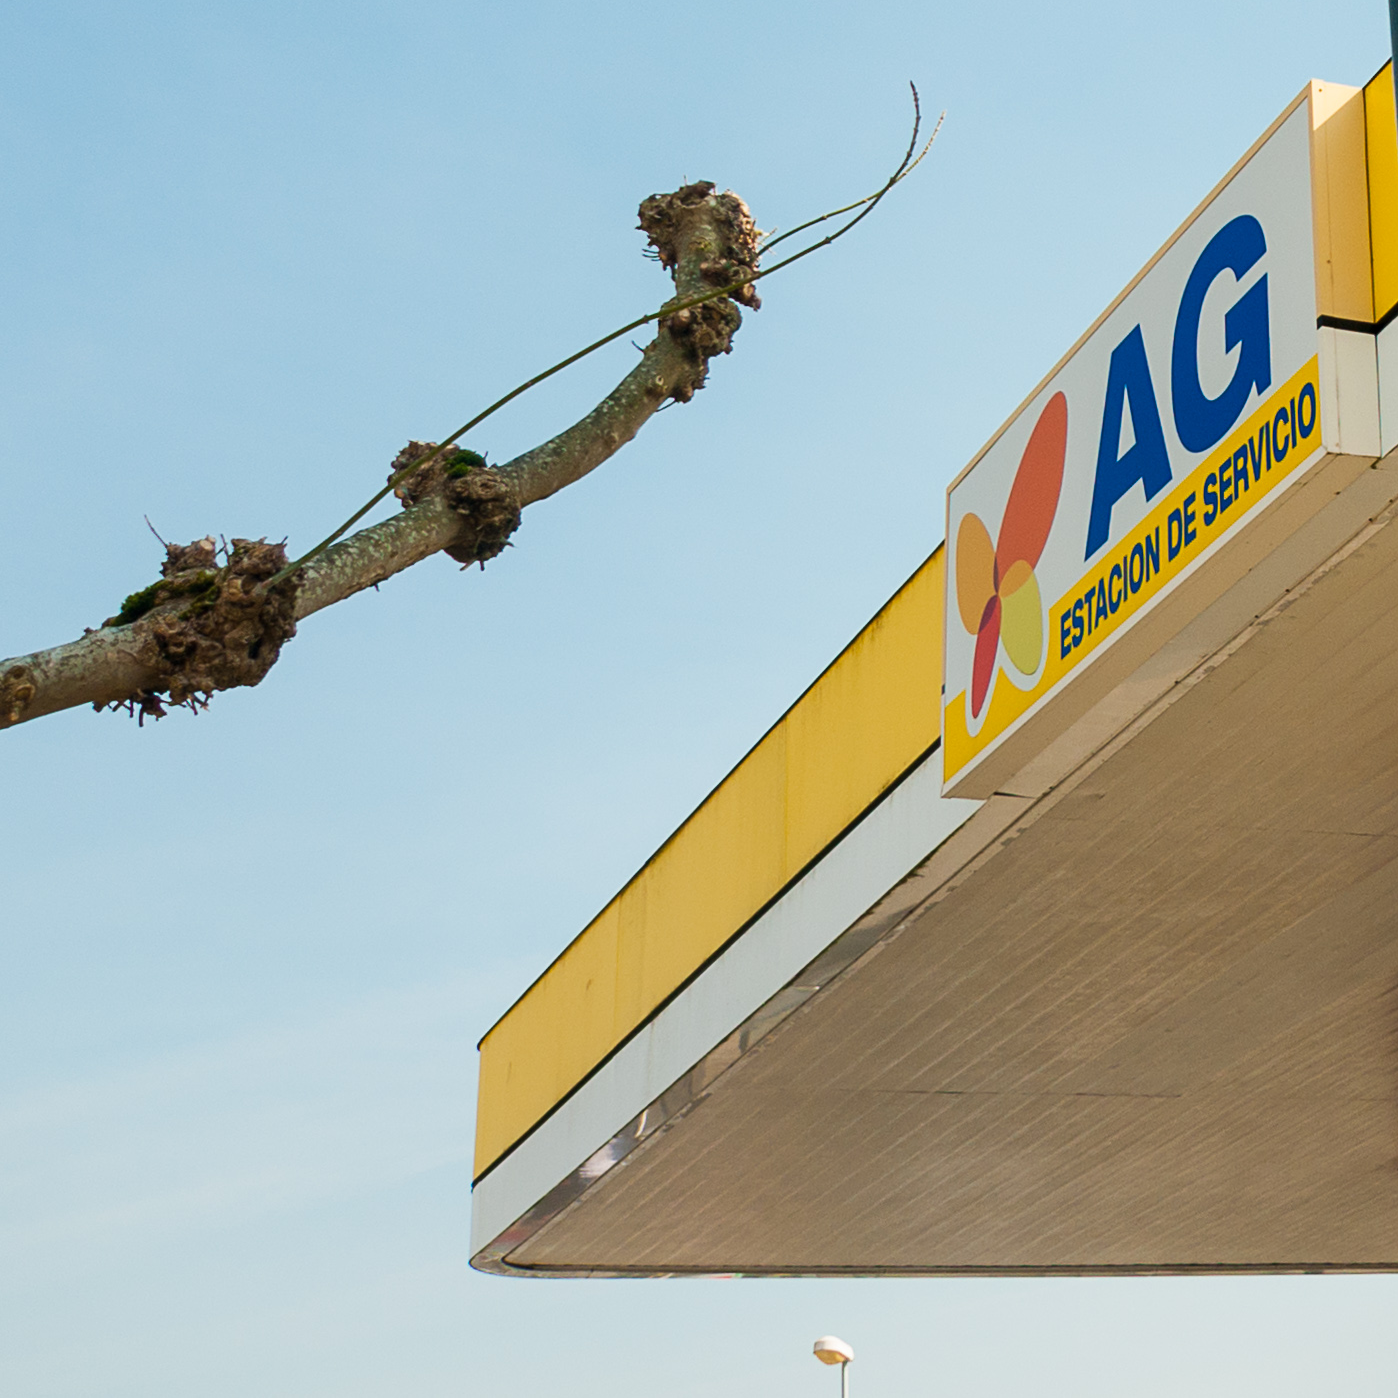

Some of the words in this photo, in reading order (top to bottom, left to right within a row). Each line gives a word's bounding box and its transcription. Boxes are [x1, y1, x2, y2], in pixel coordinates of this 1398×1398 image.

[1060, 526, 1161, 660] ESTACION
[1167, 491, 1197, 563] DE
[1203, 382, 1317, 527] SERVICIO
[1084, 213, 1271, 562] AG
